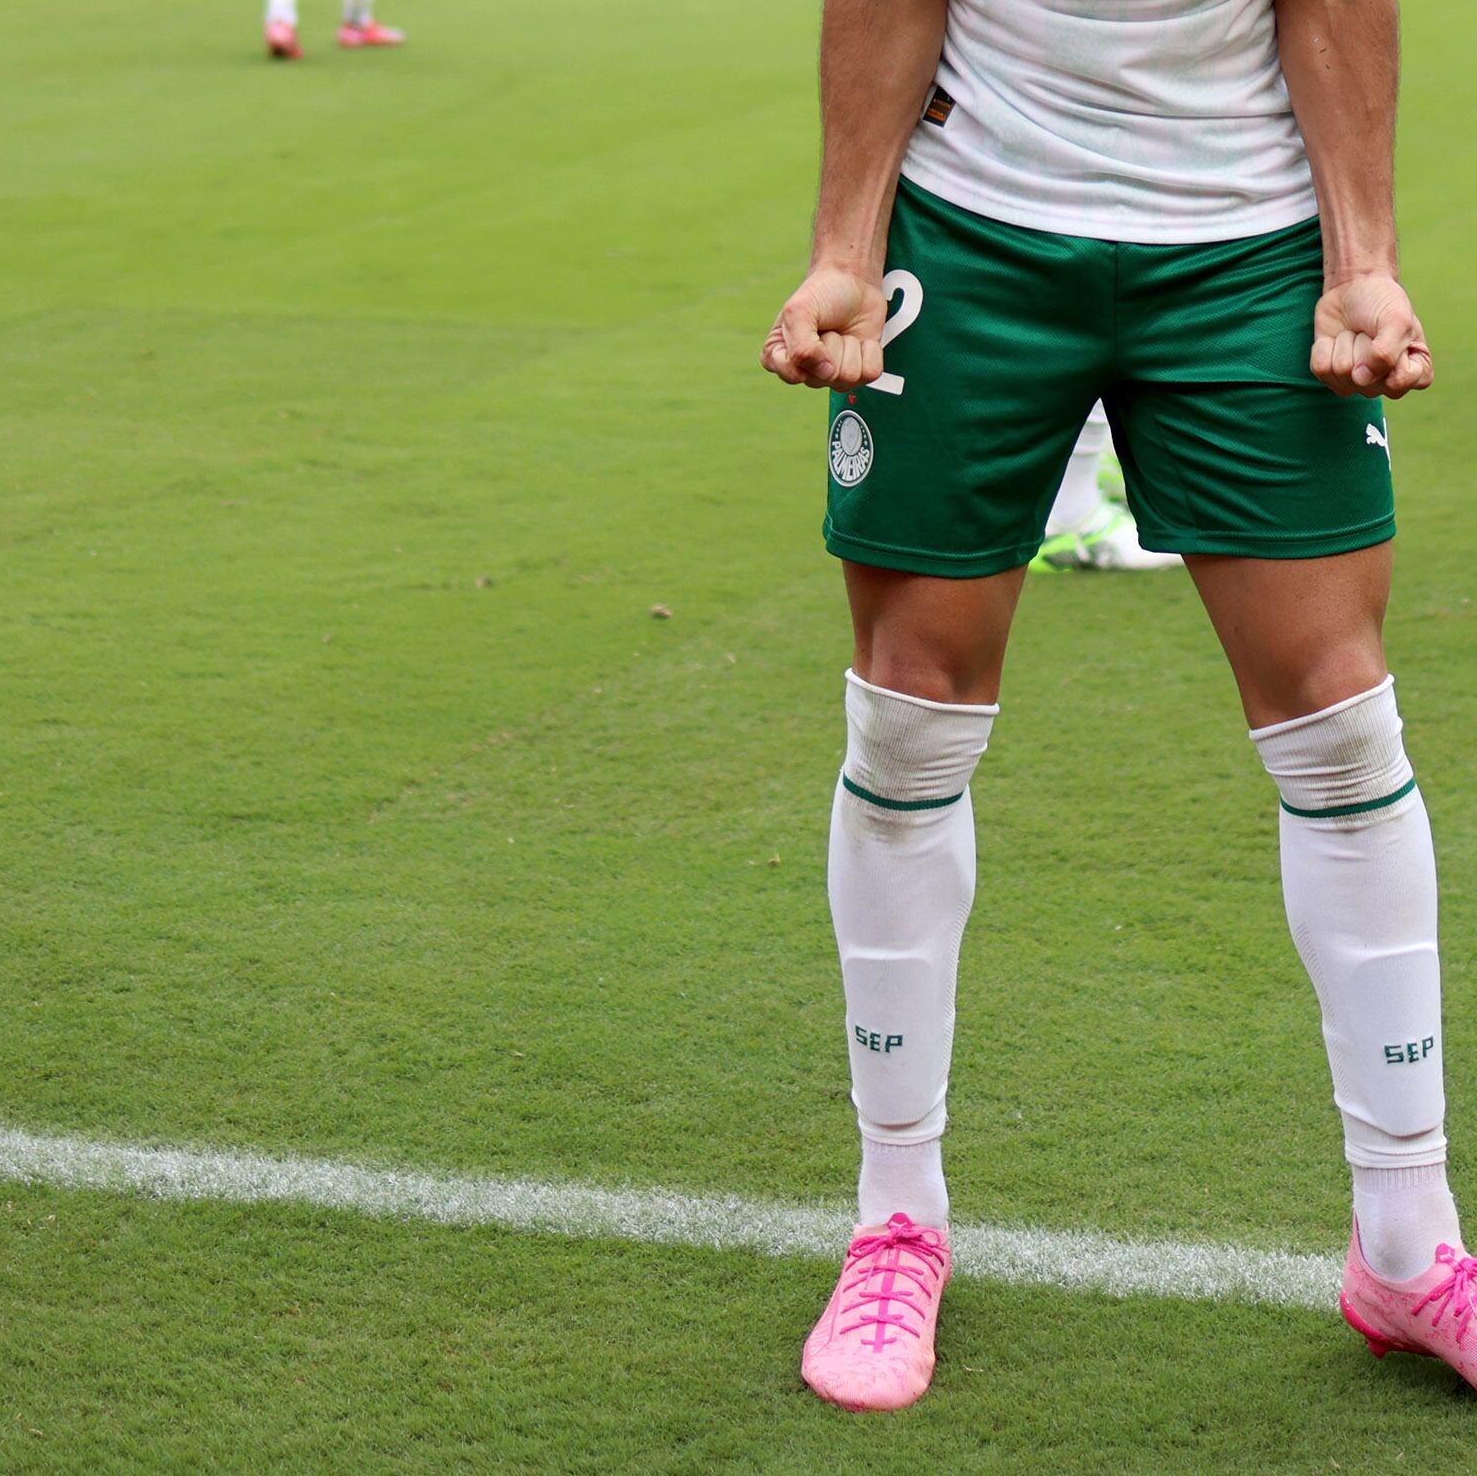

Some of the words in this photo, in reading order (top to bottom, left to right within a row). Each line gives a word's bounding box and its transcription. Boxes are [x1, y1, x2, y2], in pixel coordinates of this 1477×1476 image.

[831, 440, 872, 482] PALMEIRAS
[854, 1026, 904, 1054] SEP
[1384, 1036, 1435, 1065] SEP
